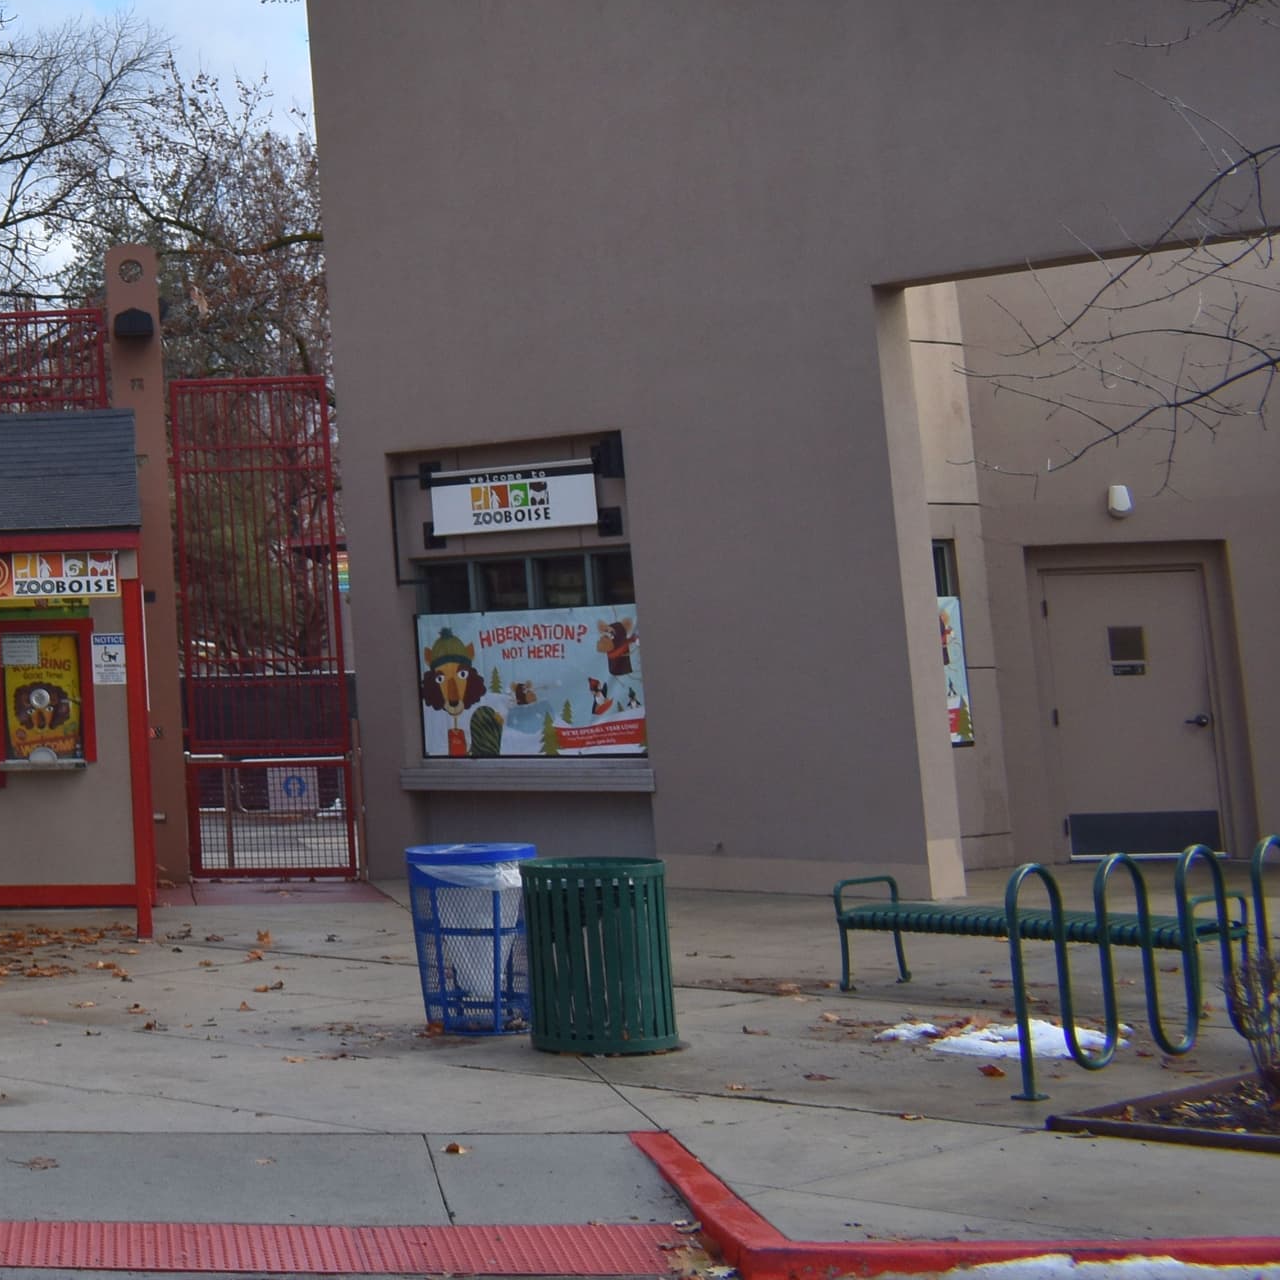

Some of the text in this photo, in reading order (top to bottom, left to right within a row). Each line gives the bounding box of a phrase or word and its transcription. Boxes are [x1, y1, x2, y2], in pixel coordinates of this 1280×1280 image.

[468, 470, 546, 484] welcome to
[479, 624, 587, 648] HIBERNATION?
[502, 643, 565, 660] NOT HERE!
